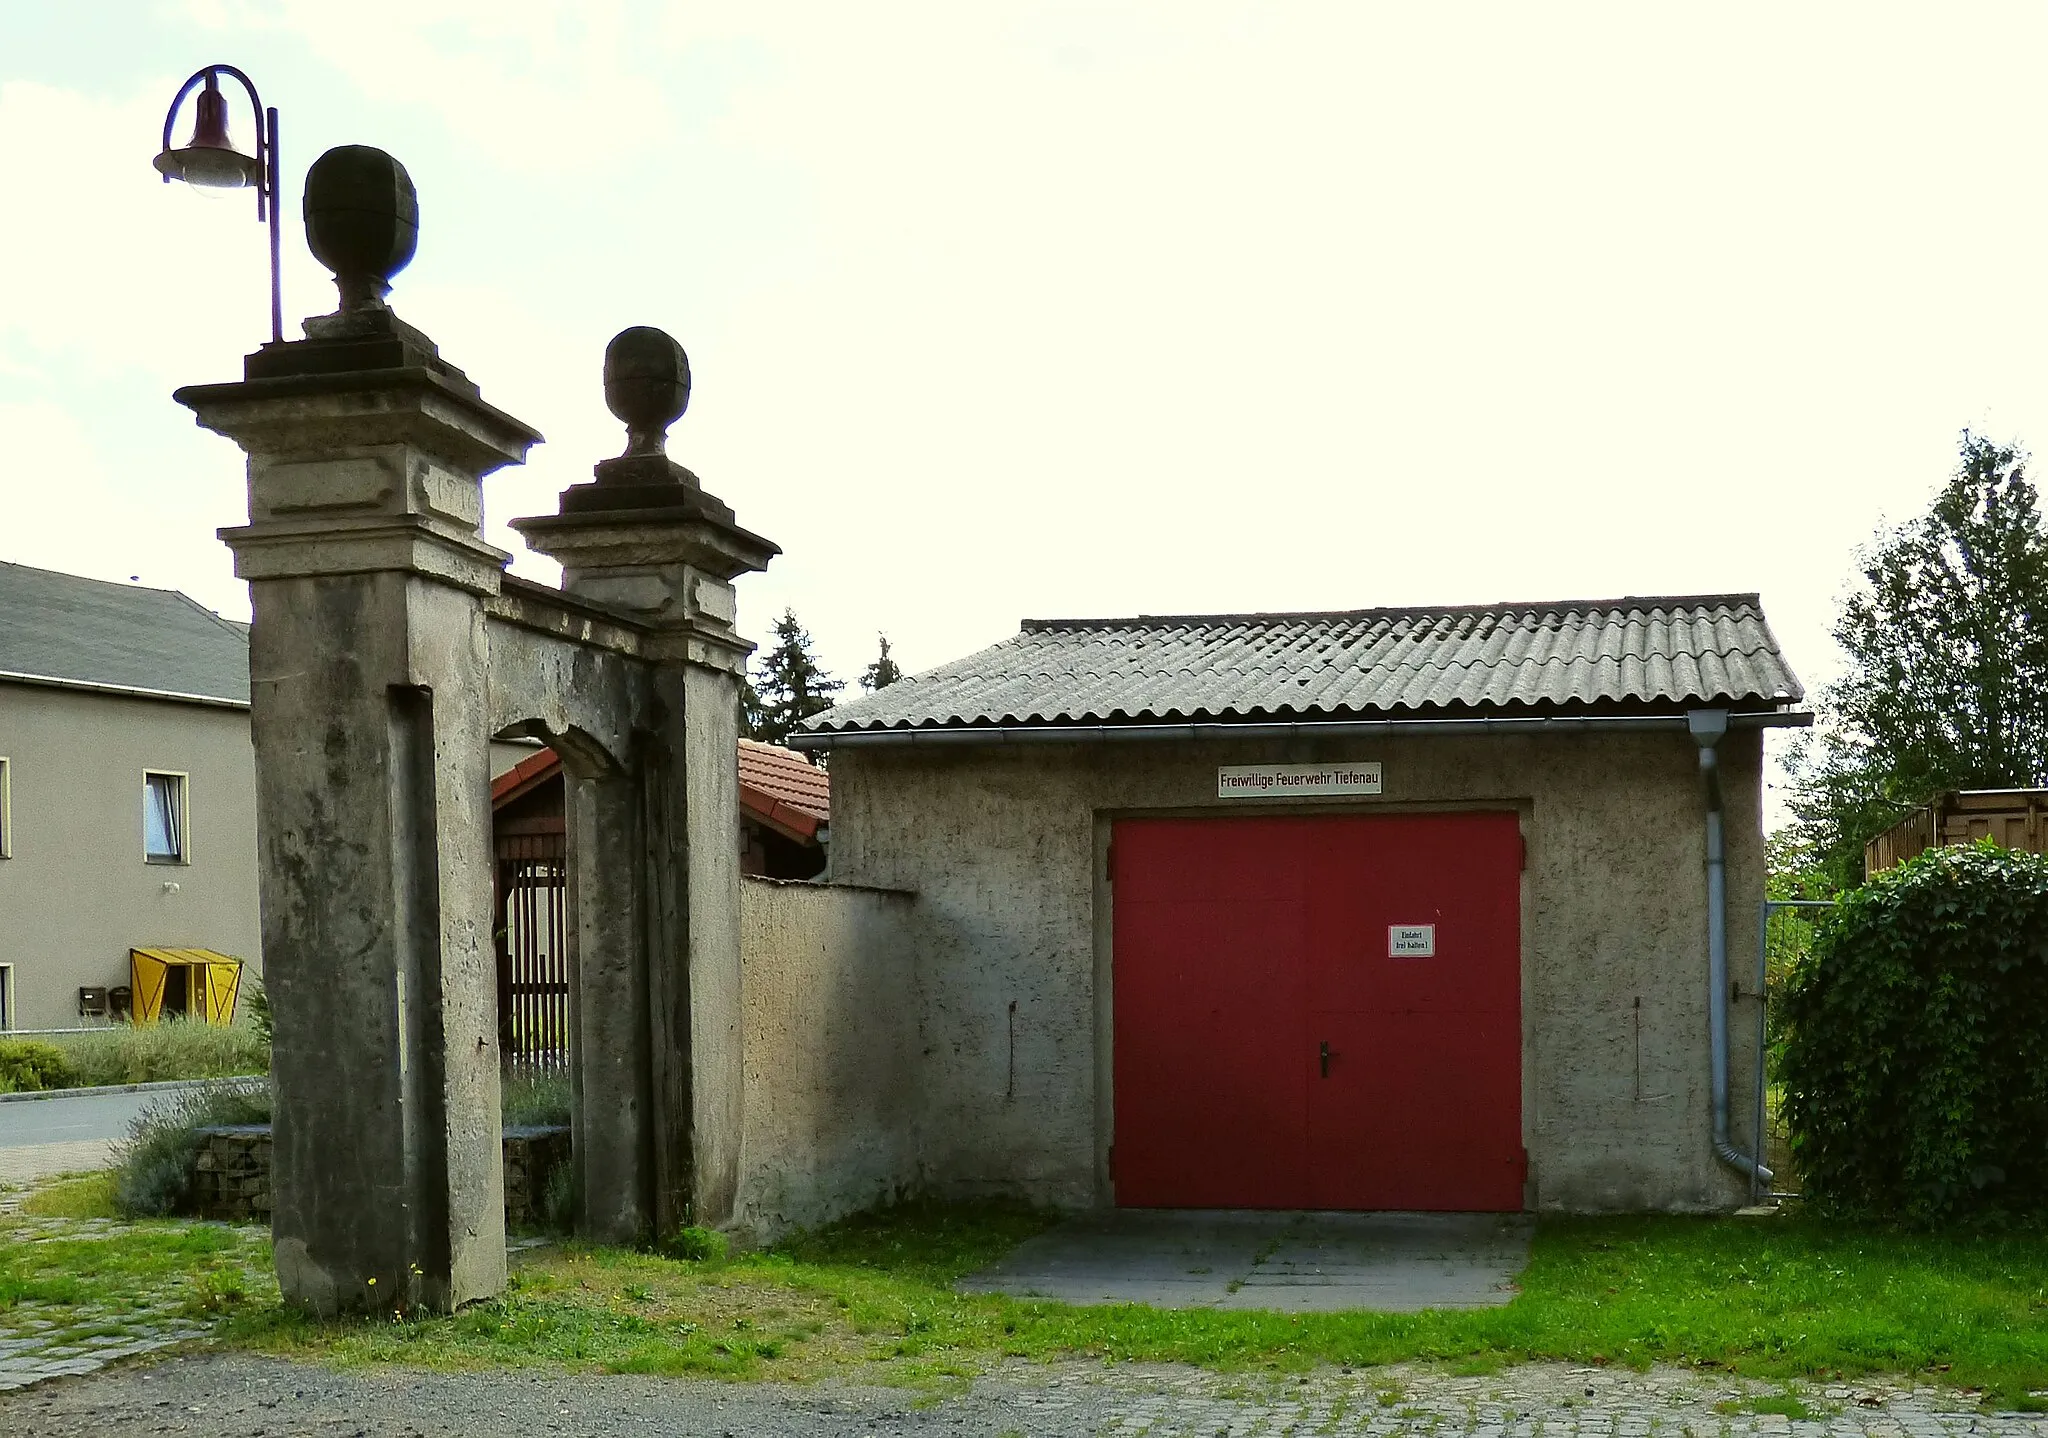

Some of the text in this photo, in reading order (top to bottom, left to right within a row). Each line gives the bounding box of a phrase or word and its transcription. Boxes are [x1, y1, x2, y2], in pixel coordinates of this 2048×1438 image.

[1220, 771, 1378, 789] Freiwillige Feuerwehr Tiefenau
